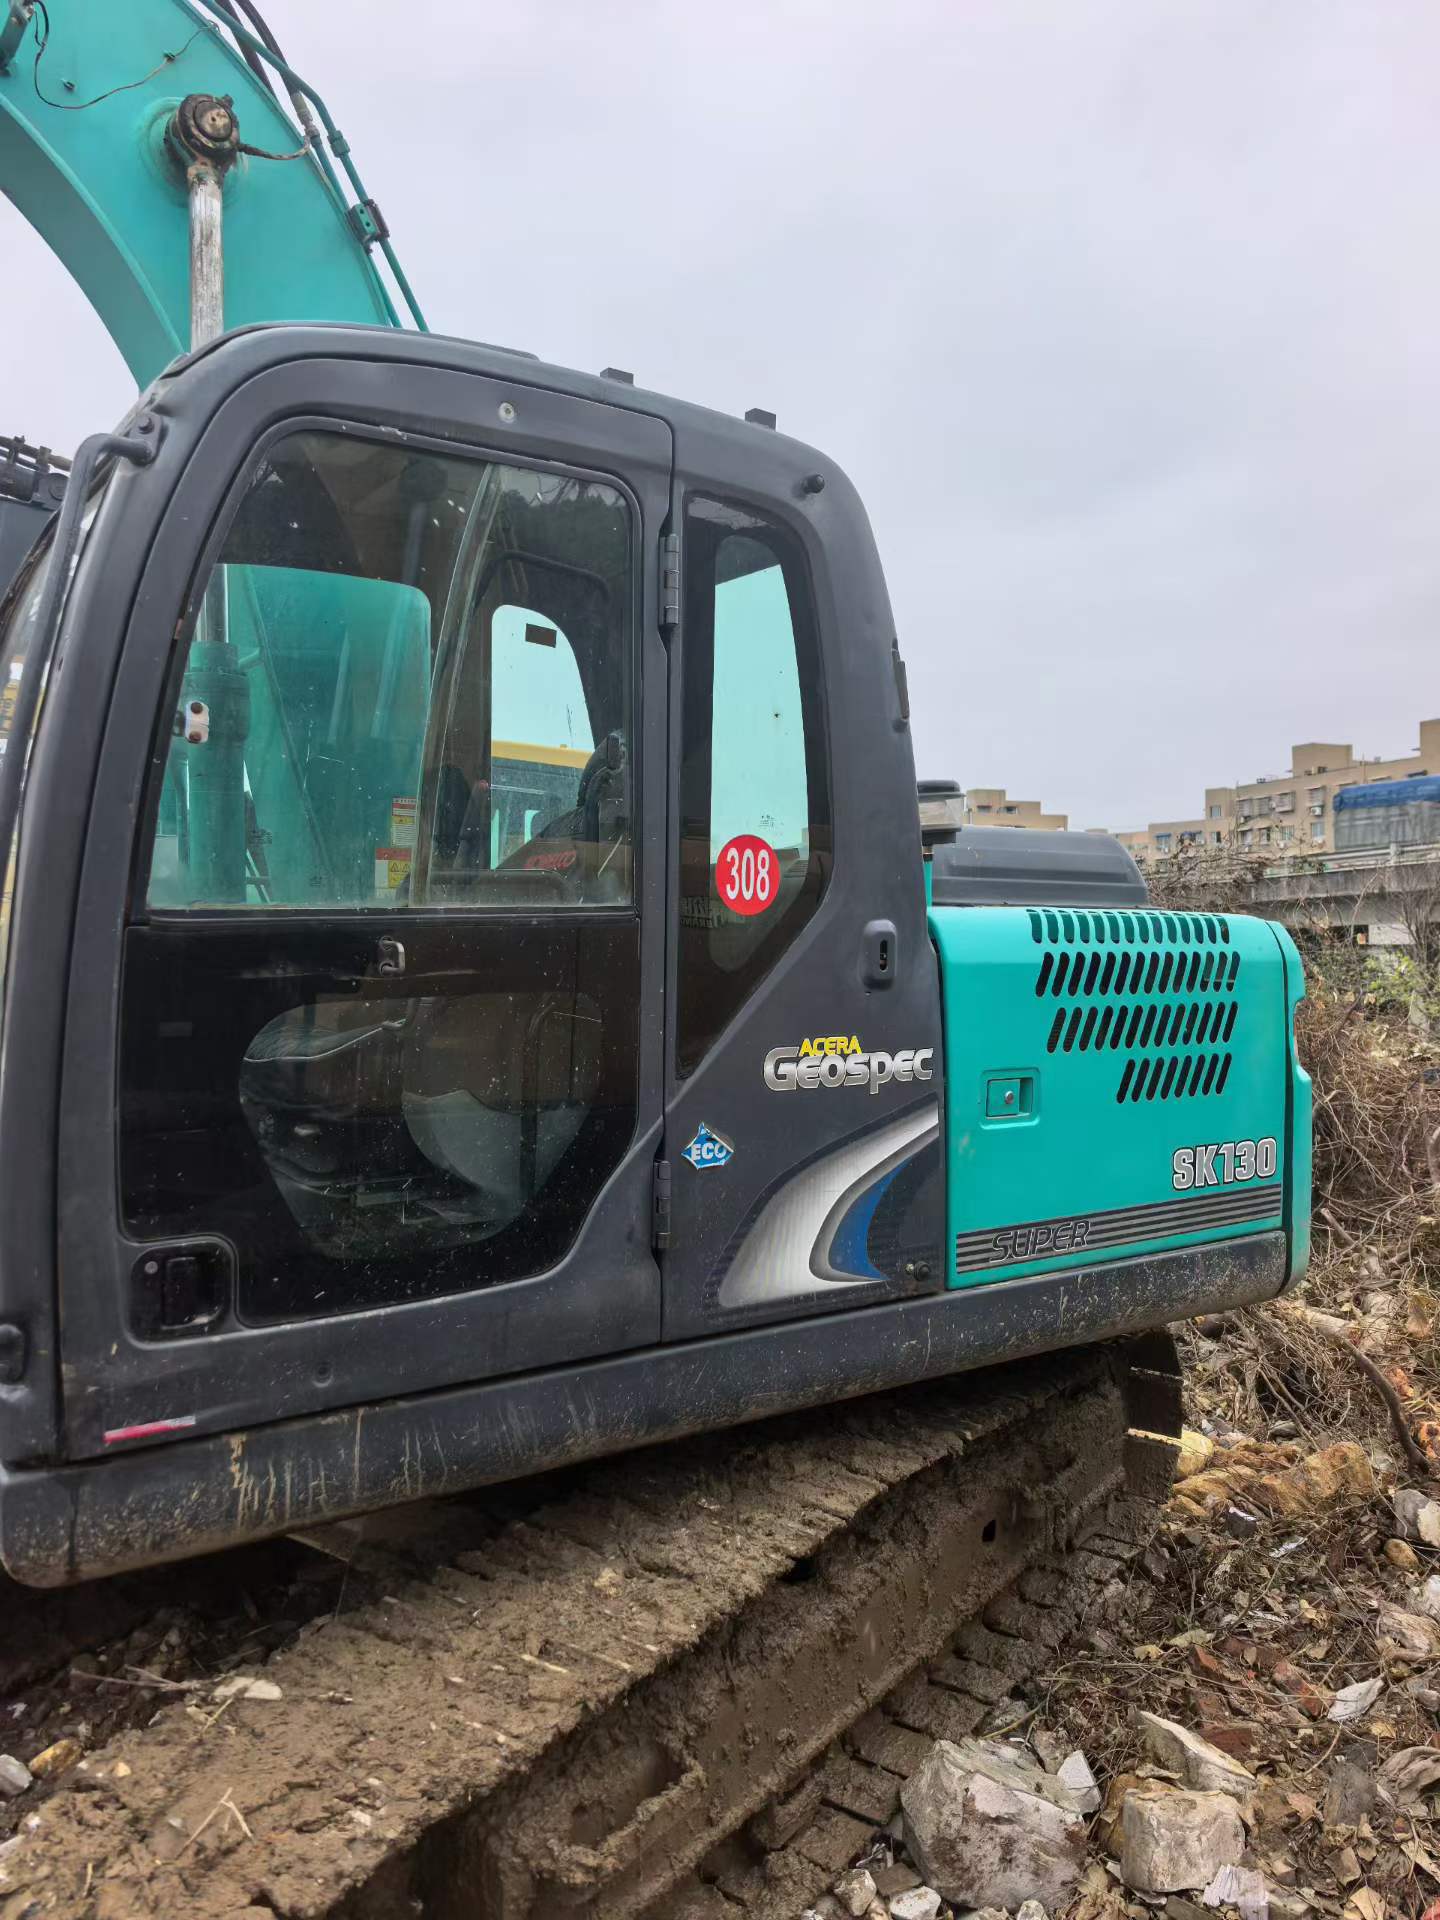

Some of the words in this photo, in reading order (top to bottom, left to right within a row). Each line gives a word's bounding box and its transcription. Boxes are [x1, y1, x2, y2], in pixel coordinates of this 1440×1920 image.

[726, 847, 770, 901] 308
[799, 1036, 862, 1057] ACERA
[691, 1142, 727, 1161] ECO
[1172, 1137, 1278, 1191] SK130
[989, 1219, 1092, 1263] SUPER
